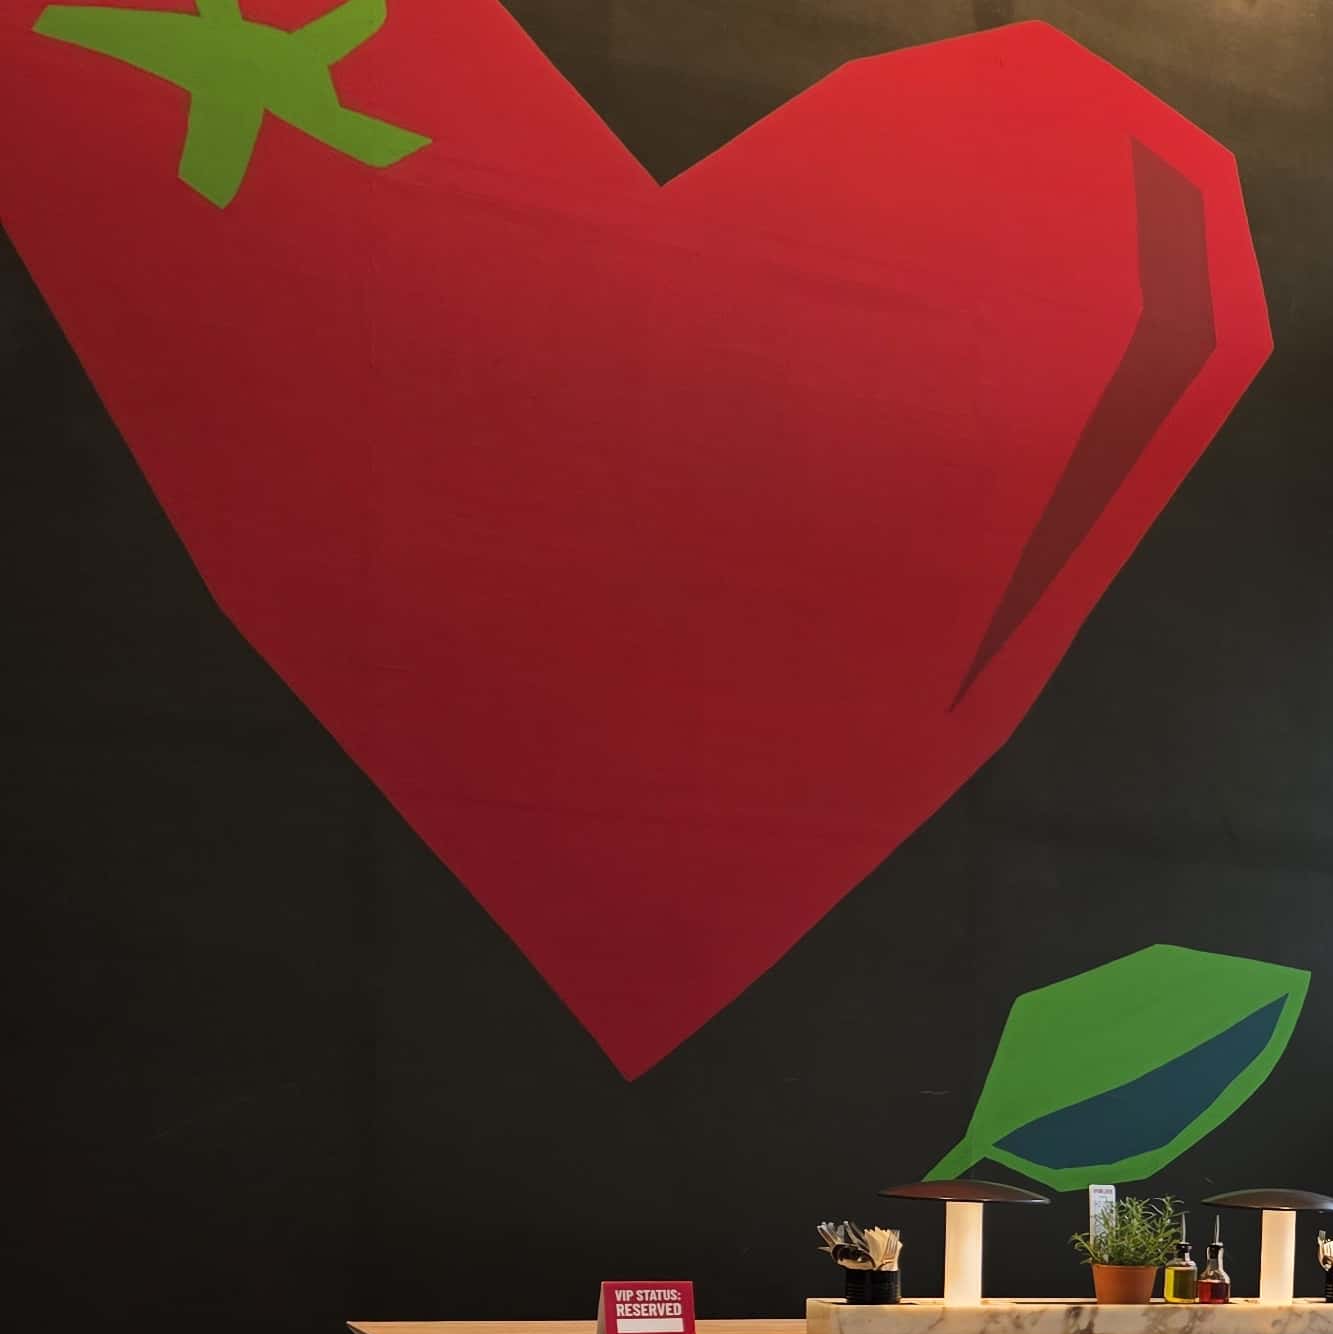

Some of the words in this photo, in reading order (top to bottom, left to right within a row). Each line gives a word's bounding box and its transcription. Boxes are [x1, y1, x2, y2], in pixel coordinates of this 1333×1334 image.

[615, 1289, 634, 1302] VIP
[636, 1288, 682, 1302] STATUS:
[616, 1302, 682, 1317] RESERVED
